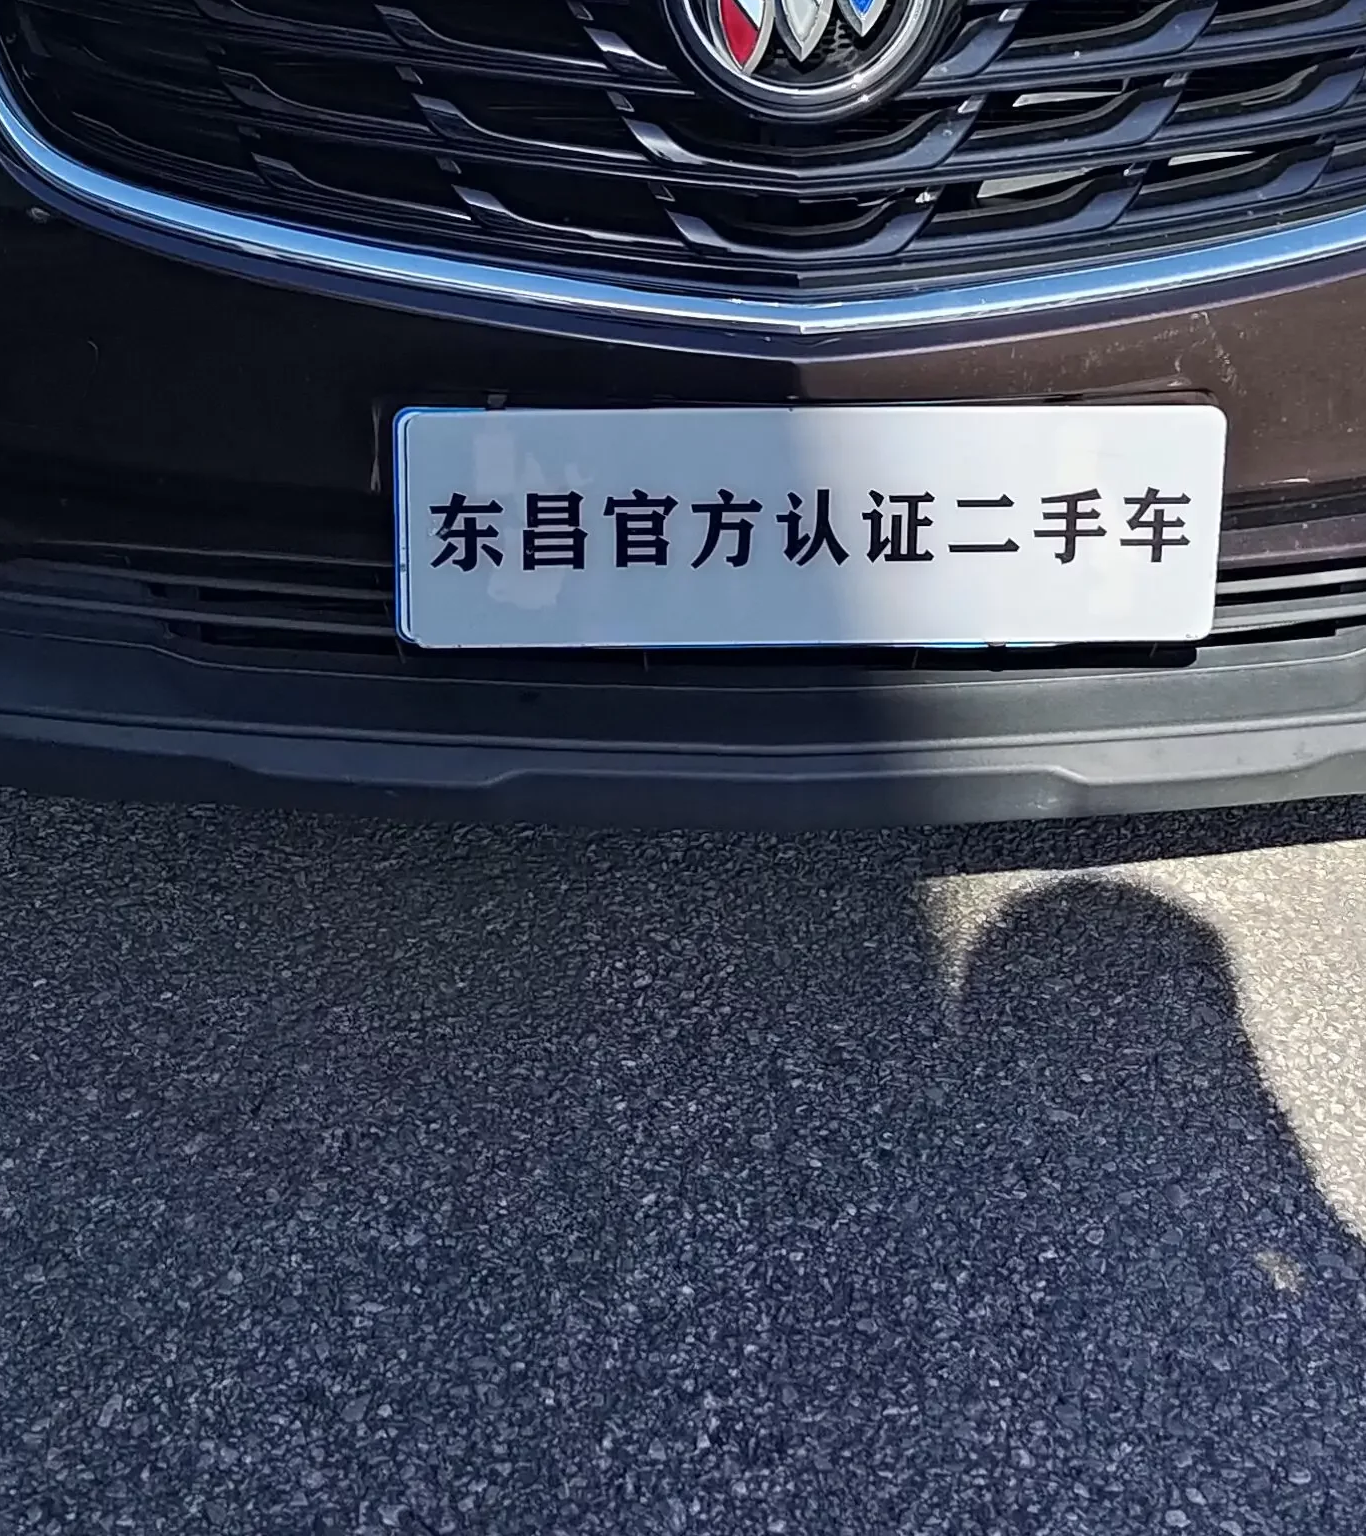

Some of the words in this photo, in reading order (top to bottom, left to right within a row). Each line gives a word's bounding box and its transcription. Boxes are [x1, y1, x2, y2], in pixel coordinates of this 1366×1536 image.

[430, 487, 1192, 571] 东昌官方认证二手车
